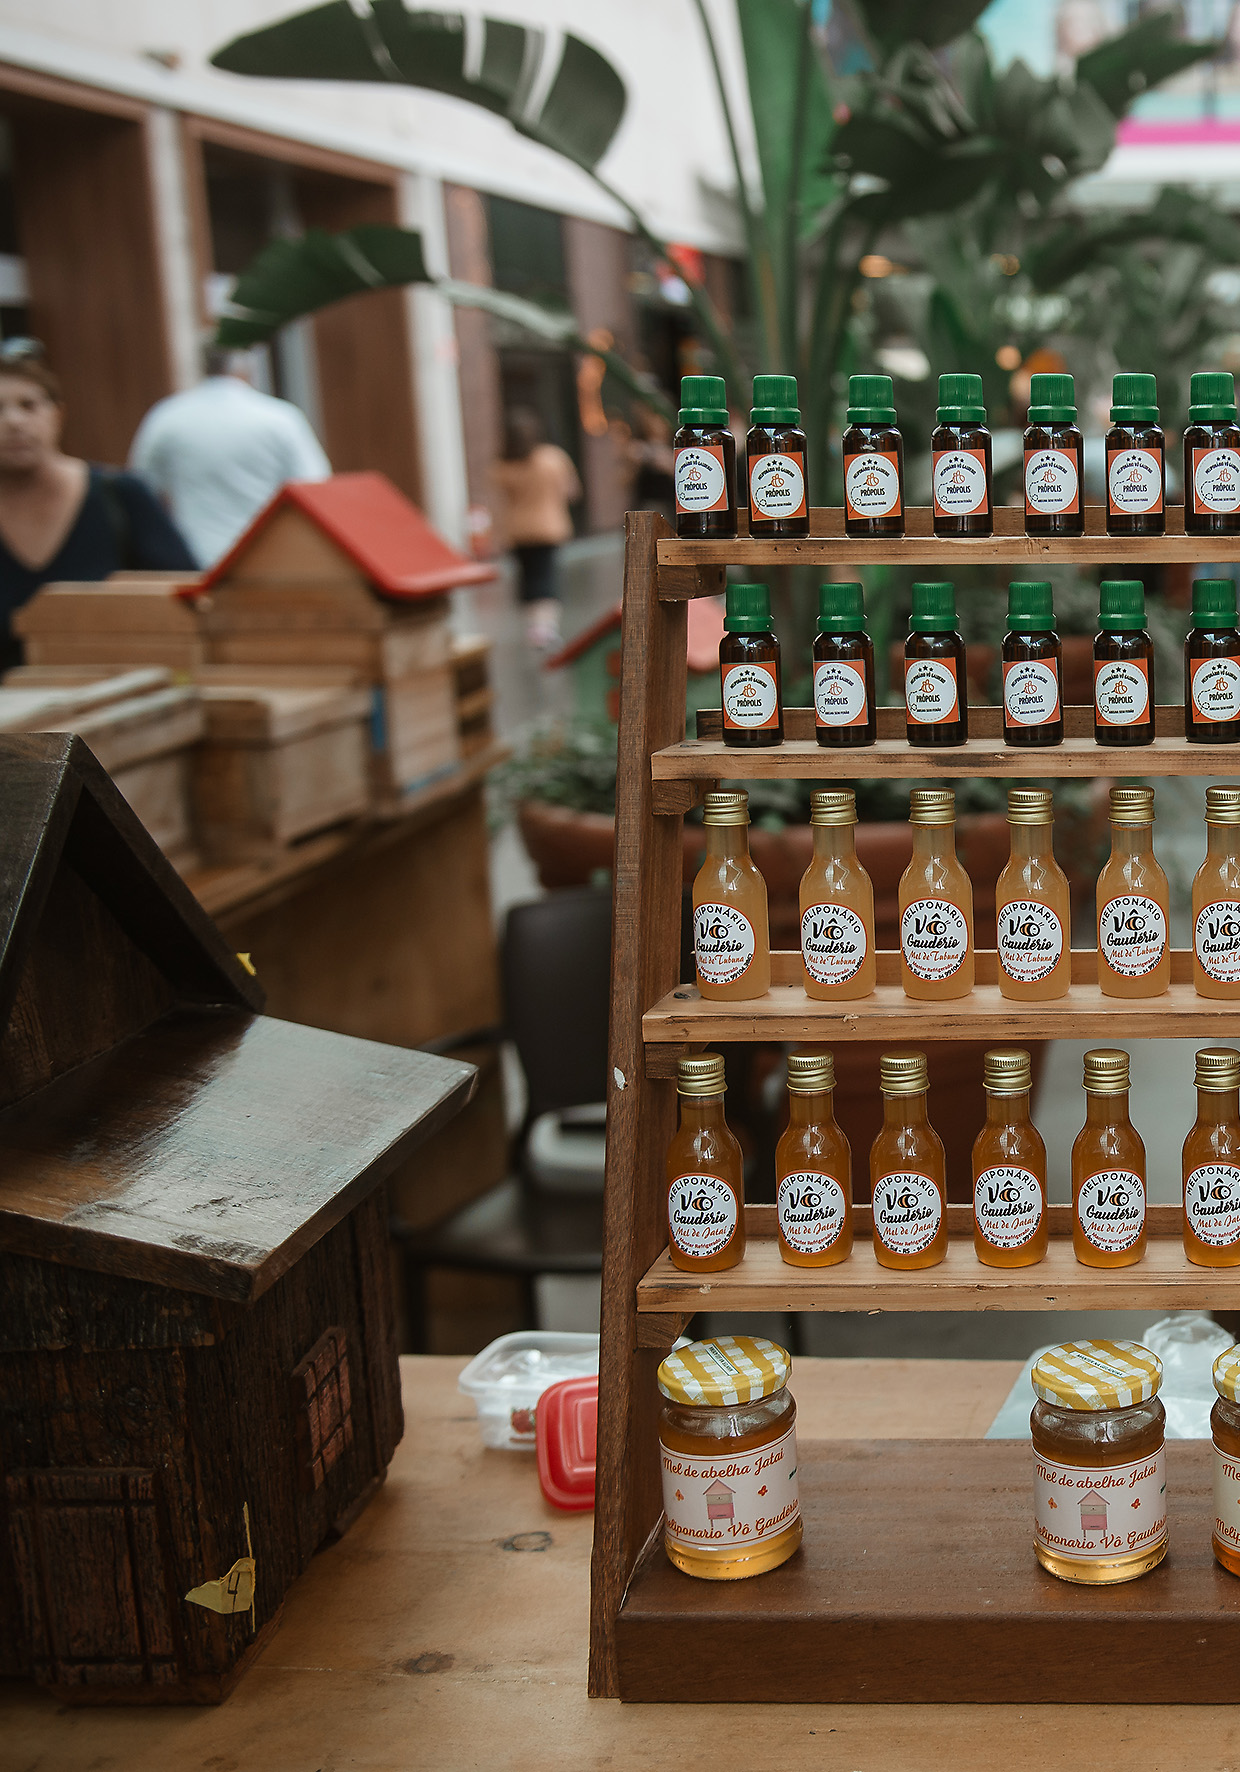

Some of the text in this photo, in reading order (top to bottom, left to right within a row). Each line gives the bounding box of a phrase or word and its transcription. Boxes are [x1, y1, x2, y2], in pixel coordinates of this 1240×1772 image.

[684, 482, 707, 491] PRÓPOLIS
[861, 487, 885, 496] PRÓPOLIS
[947, 485, 971, 494] PRÓPOLIS
[1038, 484, 1061, 492] PRÓPOLIS
[1123, 483, 1147, 492] PRÓPOLIS
[1213, 483, 1235, 491] PRÓPOLIS
[766, 488, 790, 497] PRÓPOLIS
[825, 696, 848, 705] PRÓPOLIS
[917, 694, 940, 702] PRÓPOLIS
[1019, 695, 1043, 704] PRÓPOLIS
[1109, 695, 1133, 704] PRÓPOLIS
[1209, 692, 1233, 701] PRÓPOLIS
[737, 698, 762, 707] PRÓPOLIS
[903, 901, 963, 928] MELIPONÁRIO
[999, 902, 1057, 930] MELIPONÁRIO
[1102, 898, 1161, 927] MELIPONÁRIO
[802, 906, 861, 934] MELIPONÁRIO
[976, 1169, 1036, 1196] MELIPONÁRIO
[1082, 1172, 1143, 1198] MELIPONÁRIO
[669, 1177, 731, 1203] MELIPONÁRIO
[779, 1175, 838, 1202] MELIPONÁRIO
[874, 1175, 935, 1203] MELIPONÁRIO
[664, 1457, 682, 1475] Mel
[684, 1464, 699, 1477] de
[701, 1464, 752, 1478] abelha
[1036, 1464, 1057, 1483] Mel
[1059, 1474, 1074, 1487] de
[1076, 1475, 1126, 1488] abelha
[728, 1522, 752, 1537] Vô
[1100, 1534, 1123, 1548] Vô
